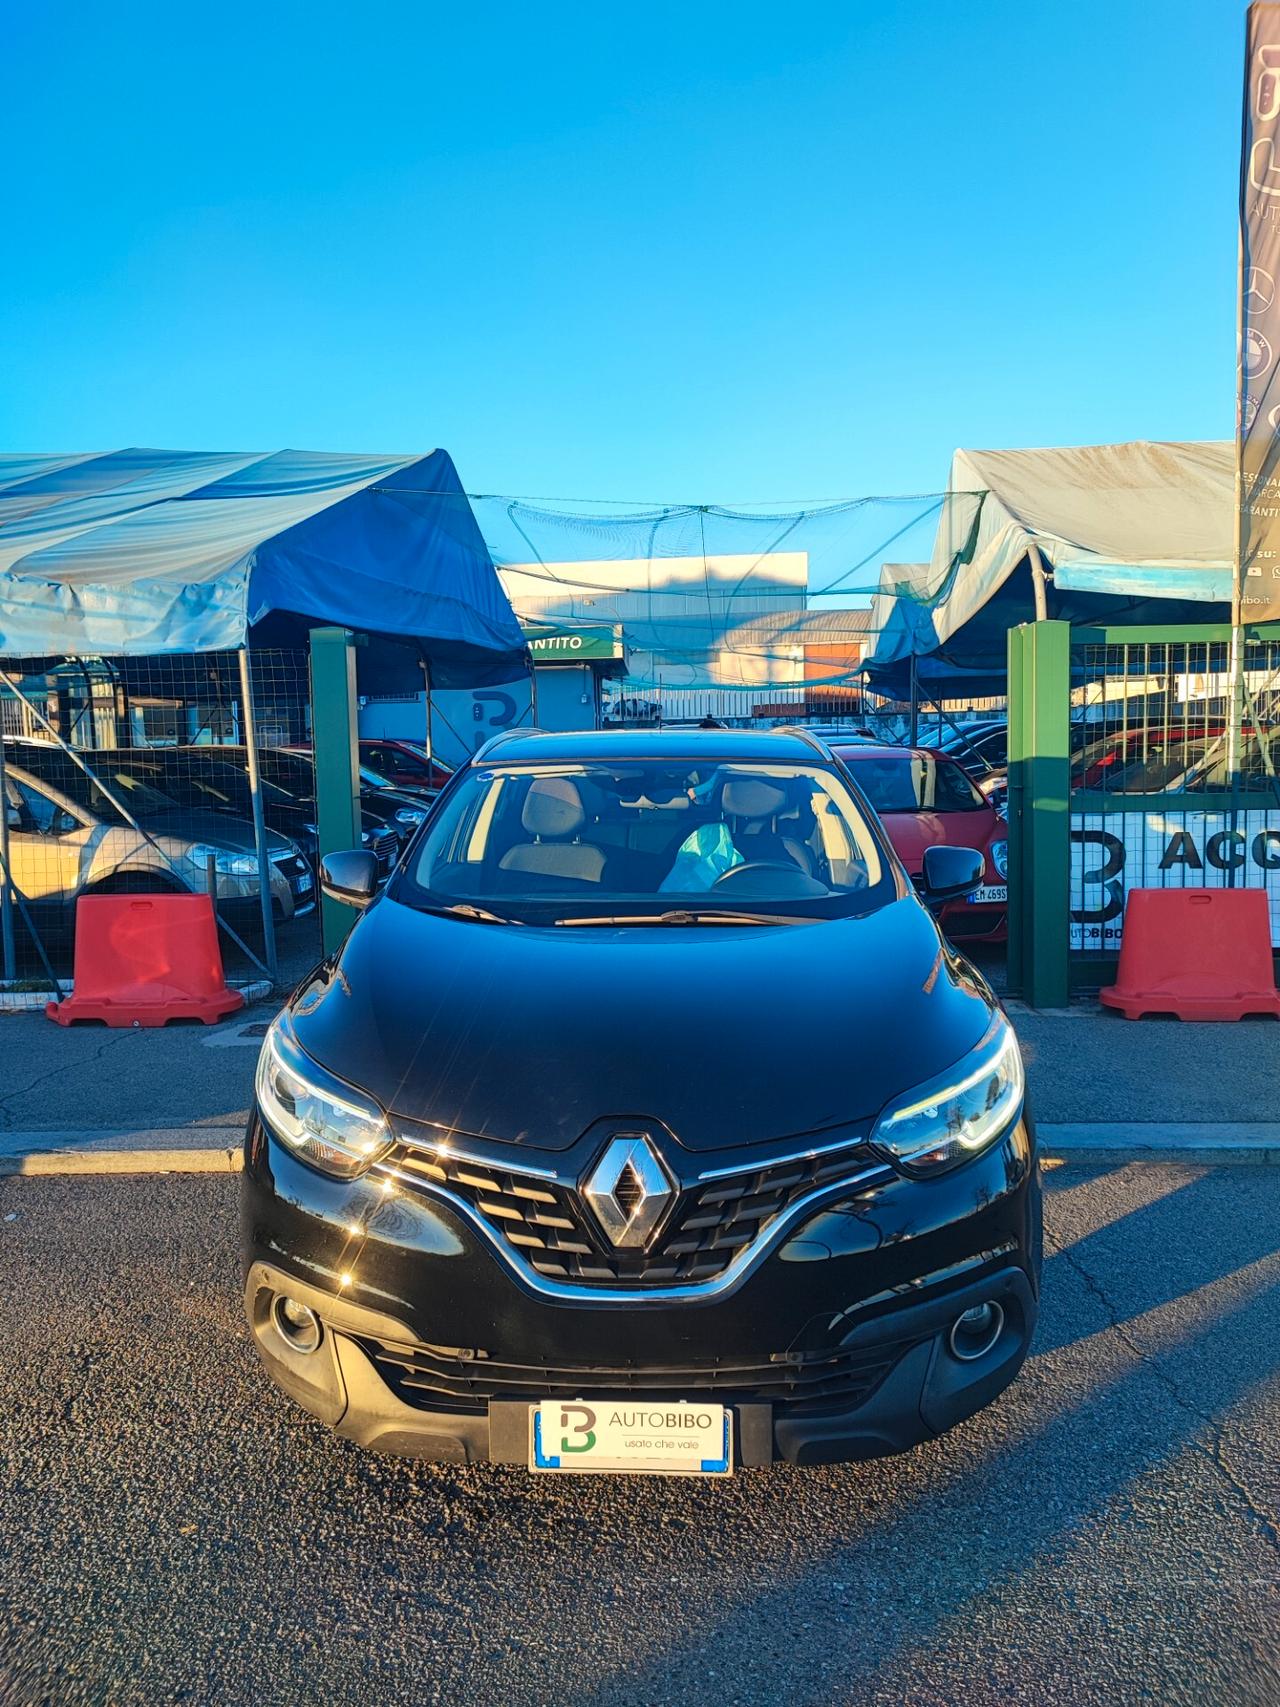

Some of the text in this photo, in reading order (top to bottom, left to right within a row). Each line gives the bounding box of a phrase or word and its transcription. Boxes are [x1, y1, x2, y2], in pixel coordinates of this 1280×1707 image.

[1250, 203, 1280, 220] AUT
[608, 1411, 712, 1429] AUTOBIBO
[624, 1439, 699, 1450] usato che vale
